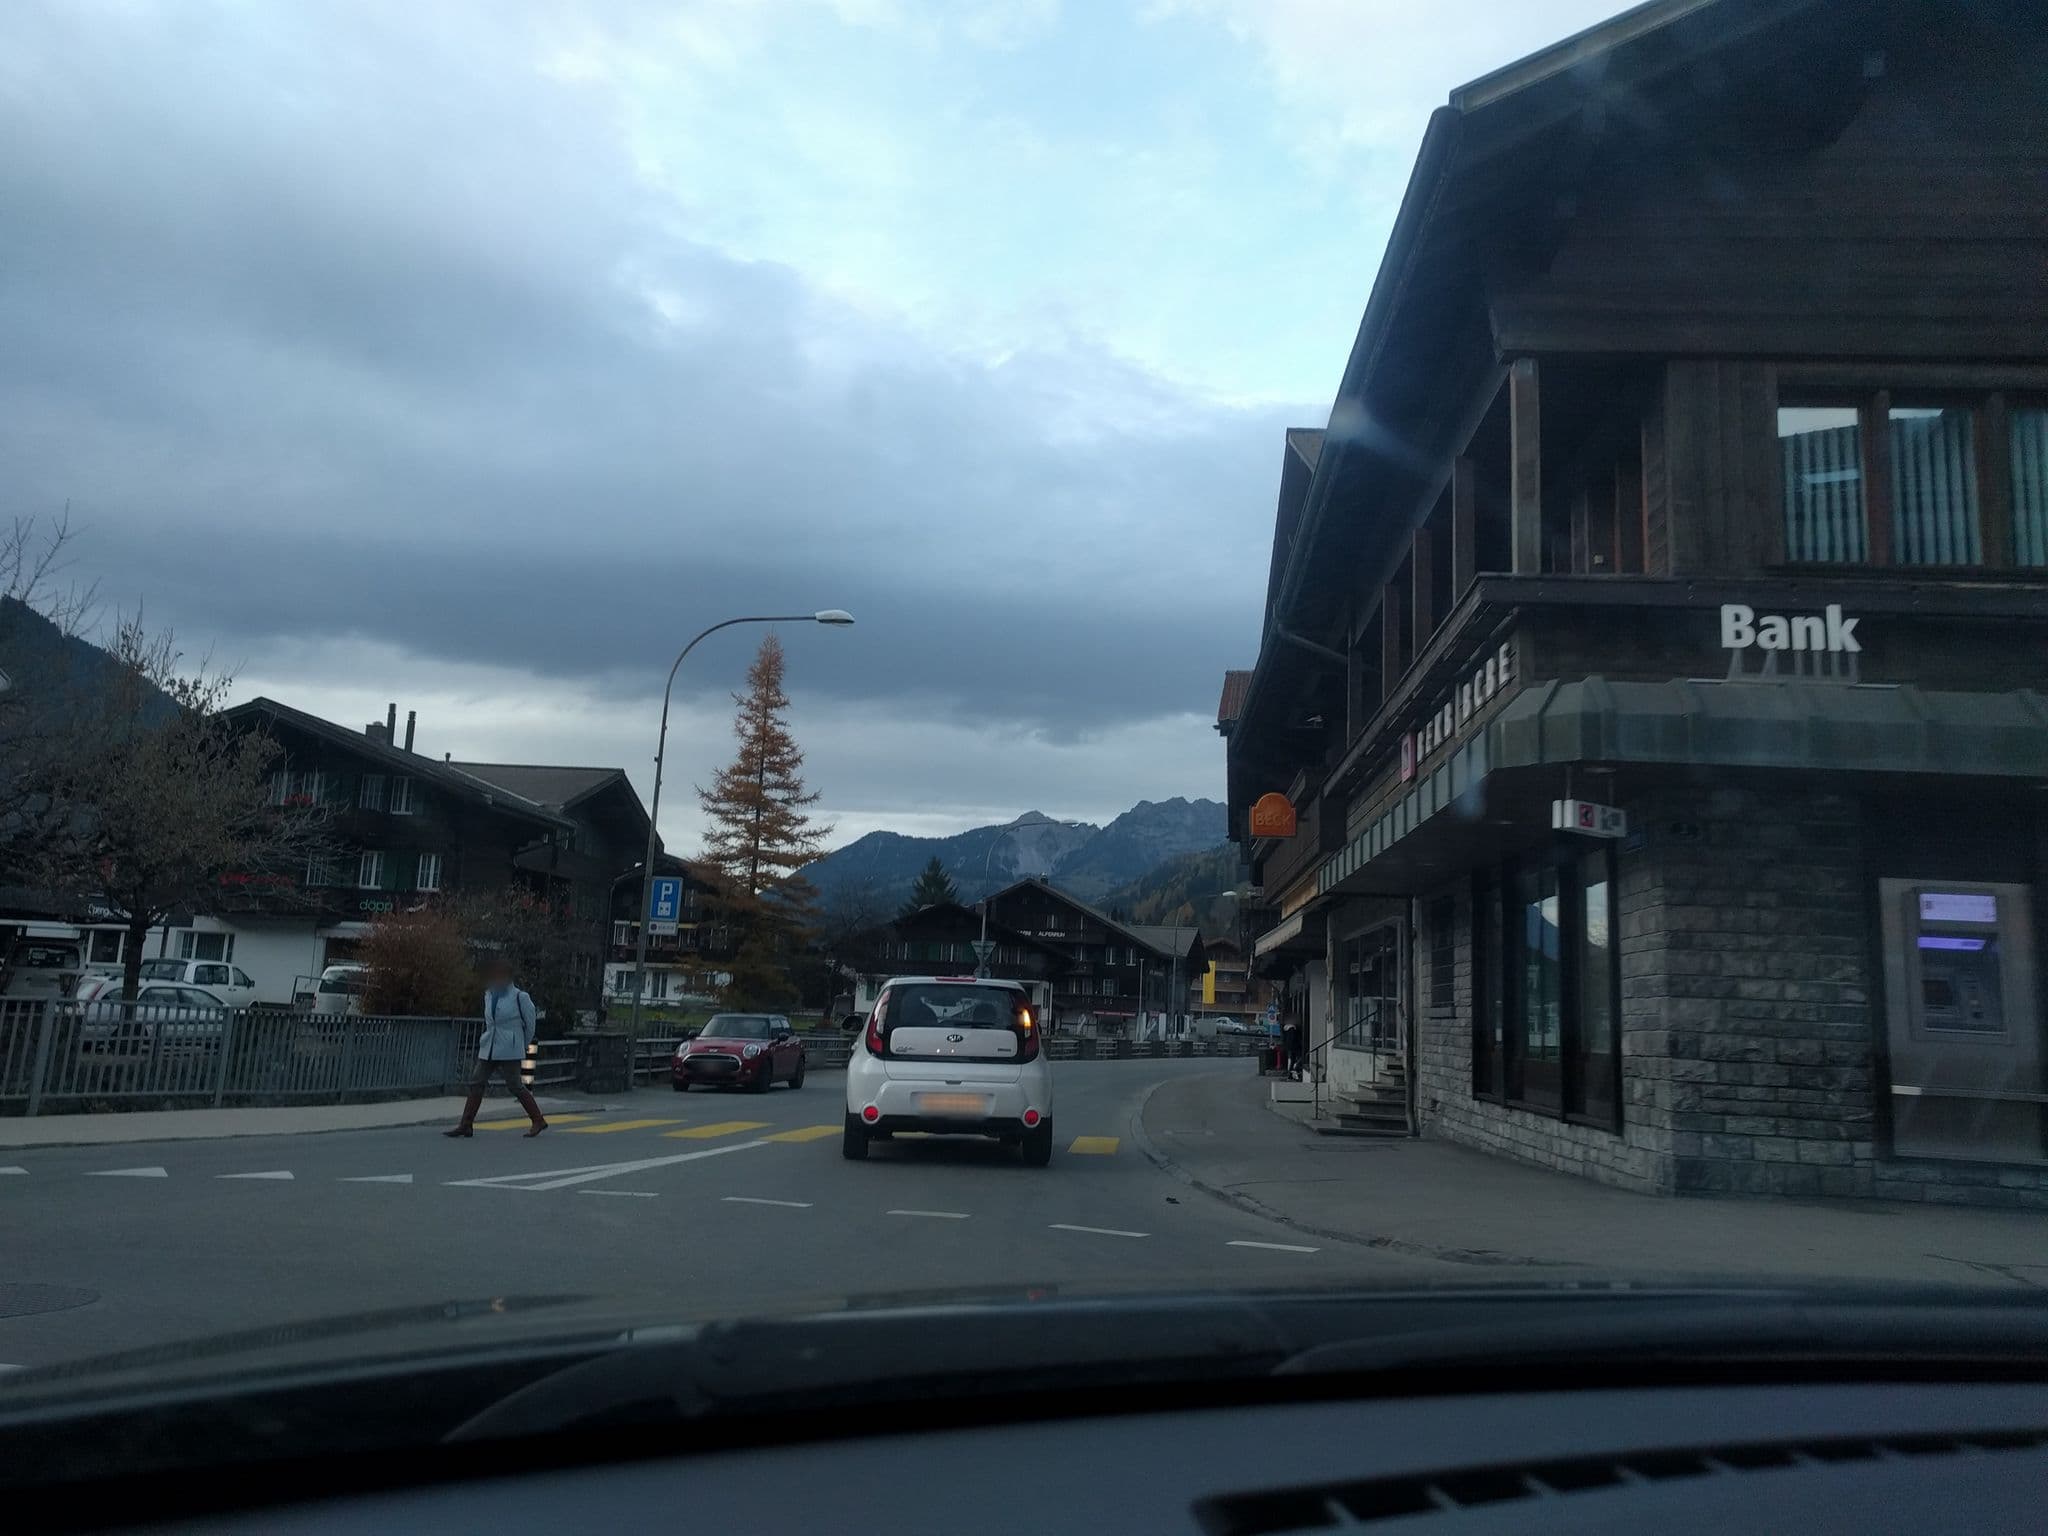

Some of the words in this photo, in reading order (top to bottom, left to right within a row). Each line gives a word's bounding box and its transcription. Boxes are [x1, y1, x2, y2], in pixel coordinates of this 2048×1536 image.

[1720, 603, 1863, 652] Bank
[1255, 811, 1291, 826] BECK
[661, 882, 673, 901] P
